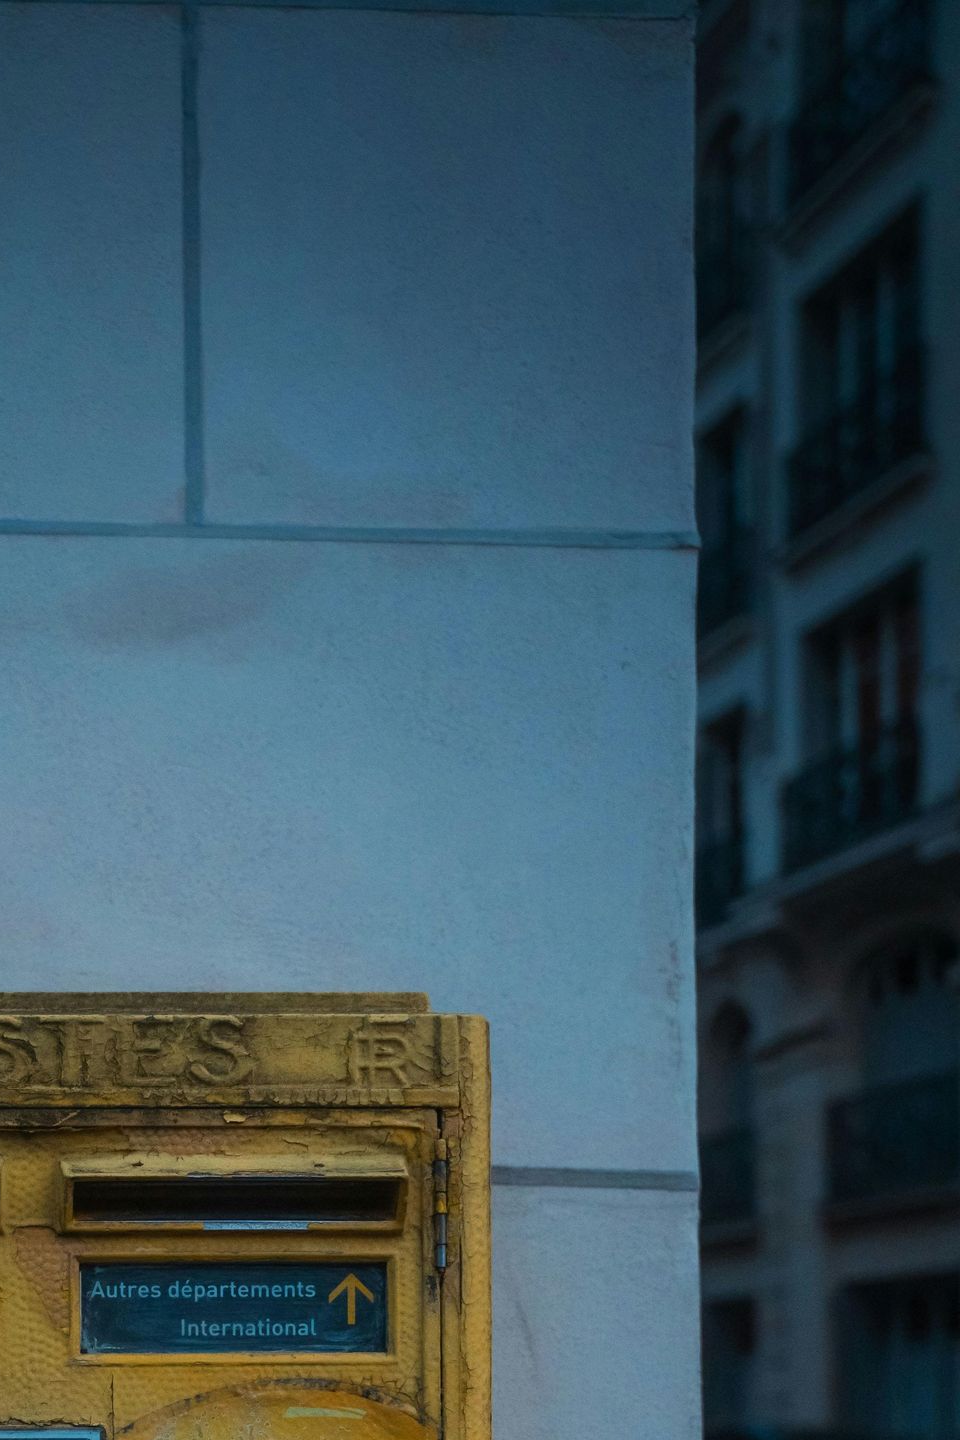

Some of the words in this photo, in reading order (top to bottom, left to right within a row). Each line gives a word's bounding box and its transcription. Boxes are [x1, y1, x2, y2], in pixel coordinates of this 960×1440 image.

[90, 1280, 162, 1299] Autres
[167, 1279, 316, 1302] départements
[180, 1318, 317, 1336] International
